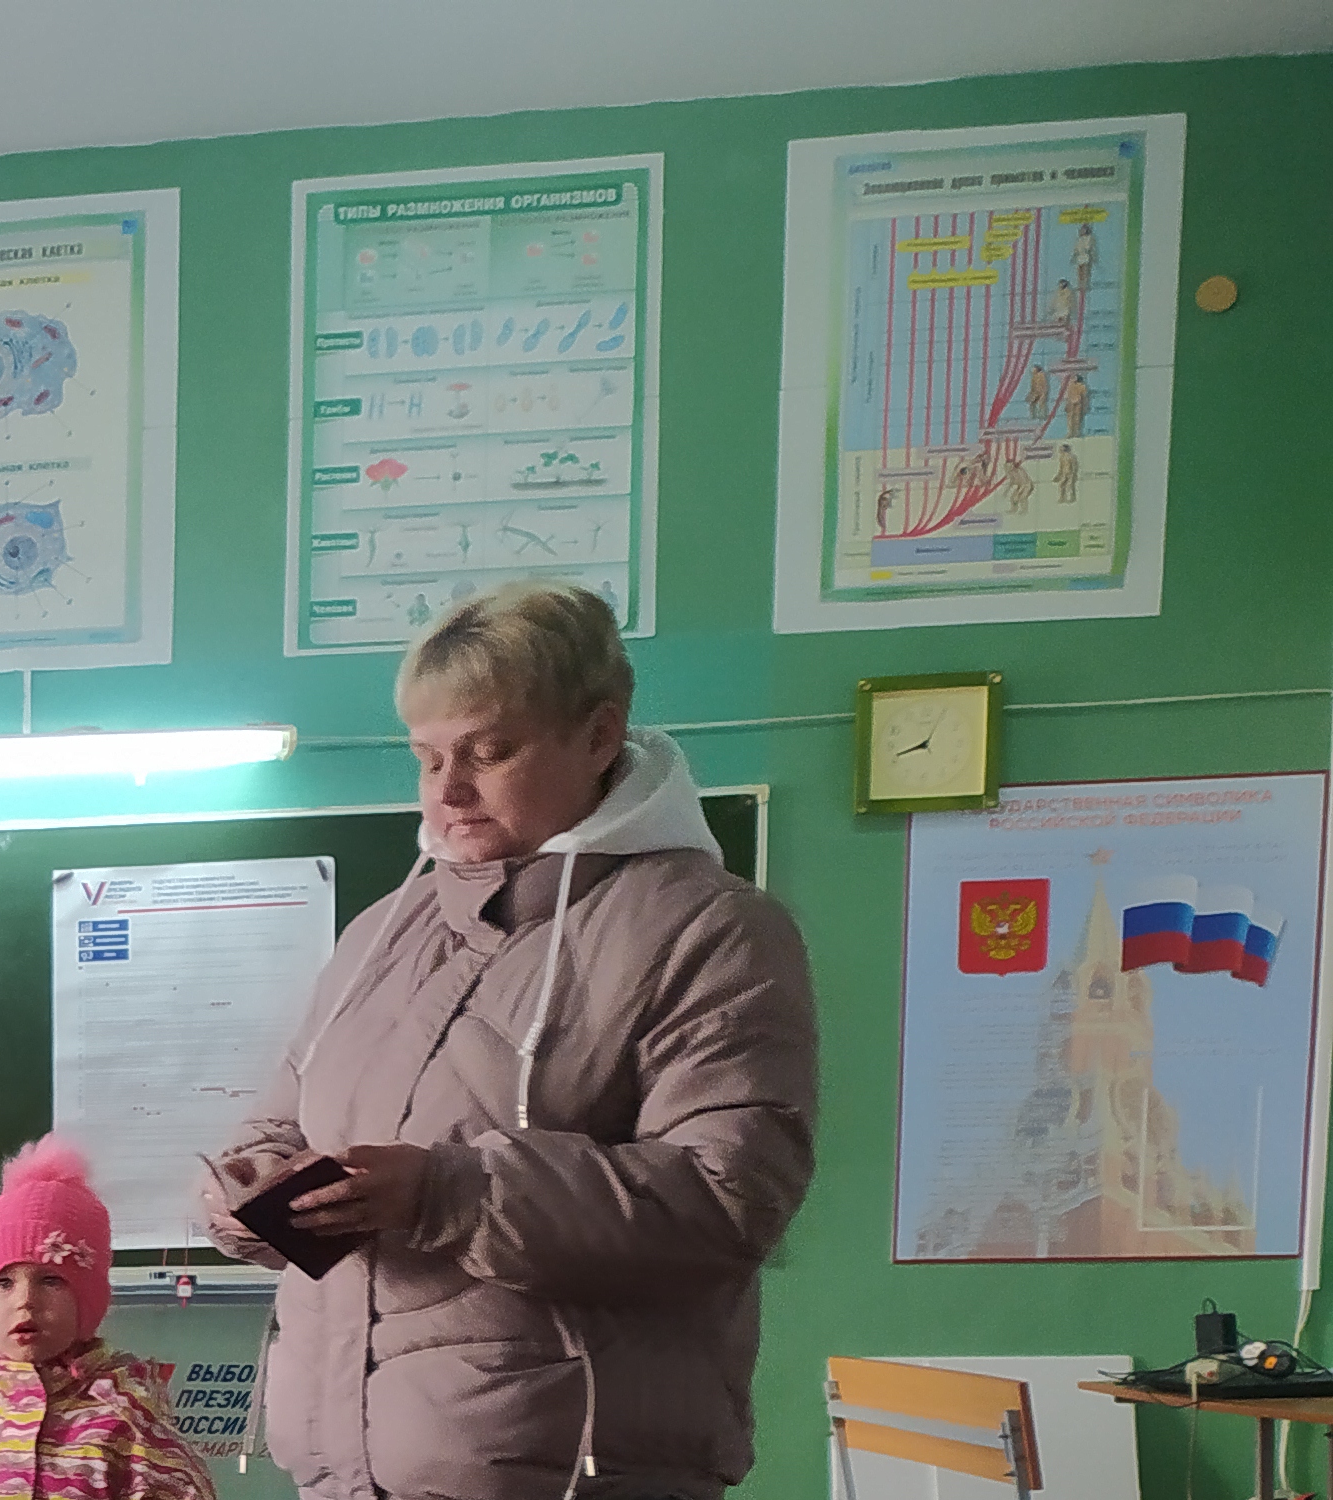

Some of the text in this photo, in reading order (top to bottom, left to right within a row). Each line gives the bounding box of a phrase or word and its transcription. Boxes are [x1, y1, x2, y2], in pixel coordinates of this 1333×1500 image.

[338, 188, 616, 220] ТИПЫ РАЗМНОЖЕНИЯ ОРГАНИЗМОВ
[1153, 789, 1272, 807] СИМВОЛИКА
[988, 809, 1242, 830] РОССИЙСКОЙ ФЕДЕРАЦИИ
[186, 1363, 256, 1384] ВЫБО
